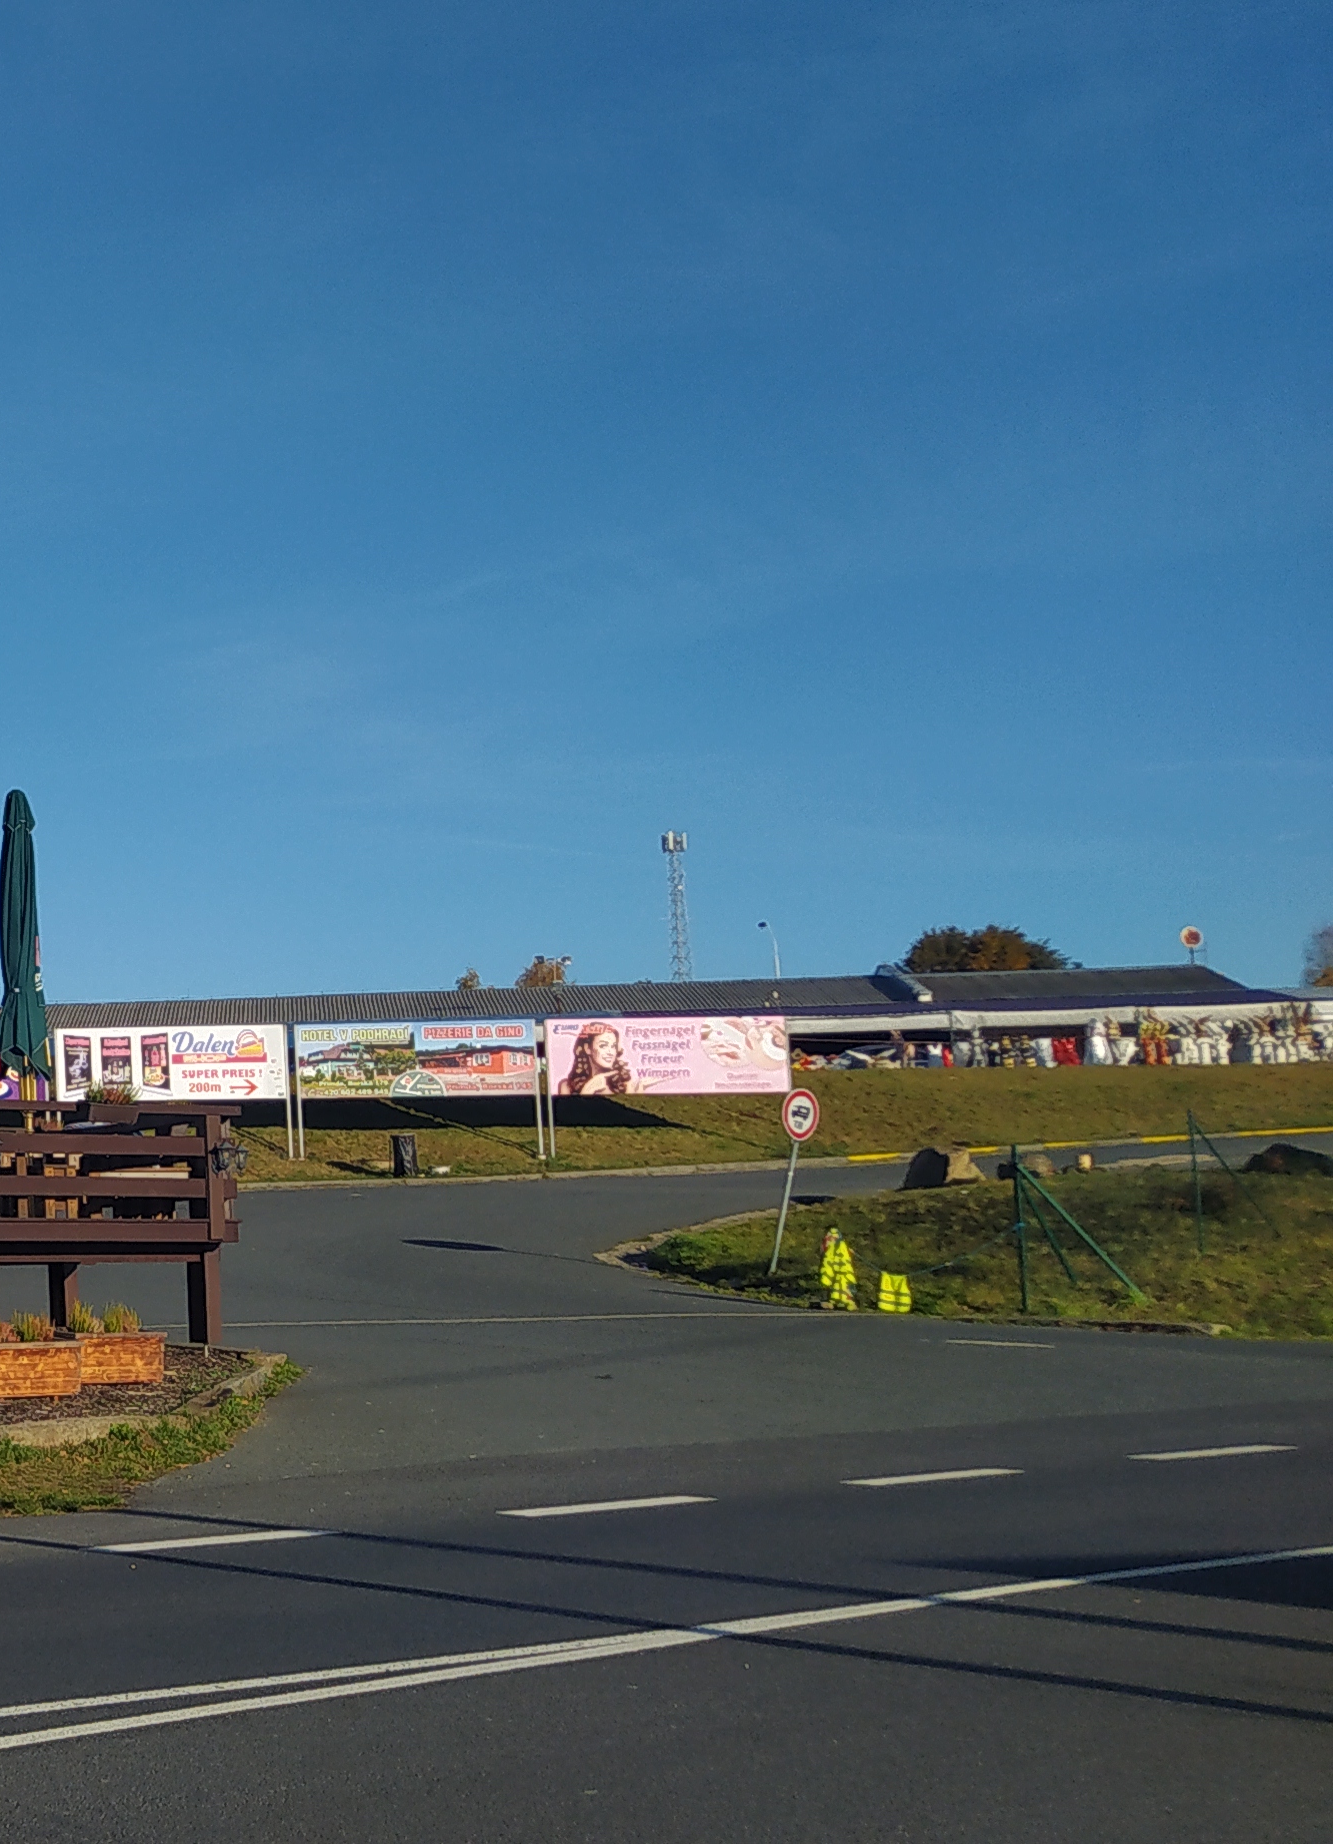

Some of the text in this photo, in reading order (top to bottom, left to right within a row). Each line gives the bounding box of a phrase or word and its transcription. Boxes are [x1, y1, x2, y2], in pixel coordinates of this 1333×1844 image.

[301, 1024, 410, 1042] HOTEL V PODHRADÍ
[424, 1025, 524, 1039] PIZZERIE DA GINO
[172, 1031, 236, 1056] Dalen
[641, 1054, 684, 1064] Friseur
[182, 1069, 219, 1079] SUPER
[222, 1069, 256, 1078] PREIS
[637, 1068, 691, 1078] Wimpern
[189, 1082, 222, 1093] 200m
